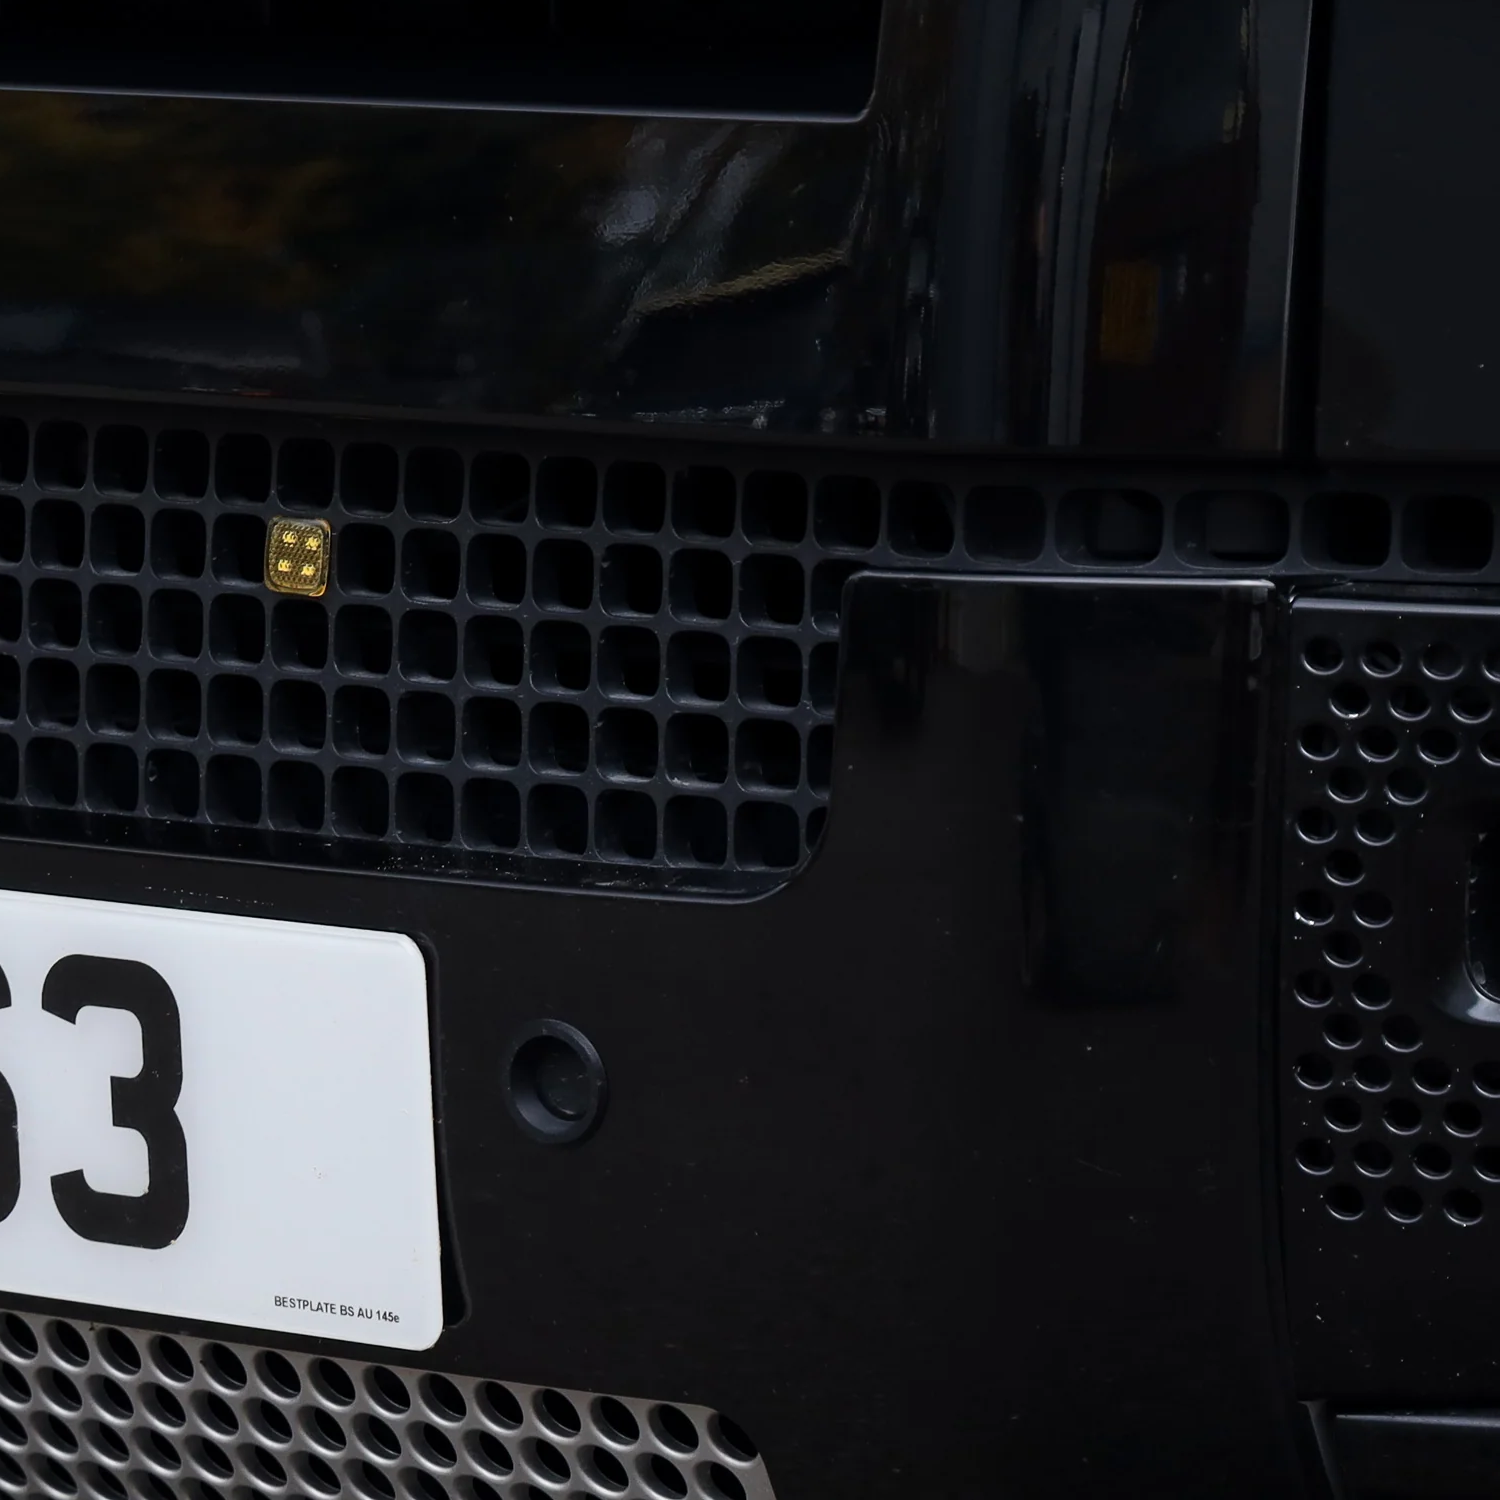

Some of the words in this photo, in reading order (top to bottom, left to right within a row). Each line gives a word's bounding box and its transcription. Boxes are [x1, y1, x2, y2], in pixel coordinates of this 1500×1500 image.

[273, 1295, 337, 1315] BESTPLATE
[339, 1304, 355, 1318] BS
[357, 1307, 373, 1320] AU
[375, 1309, 400, 1324] 145e
